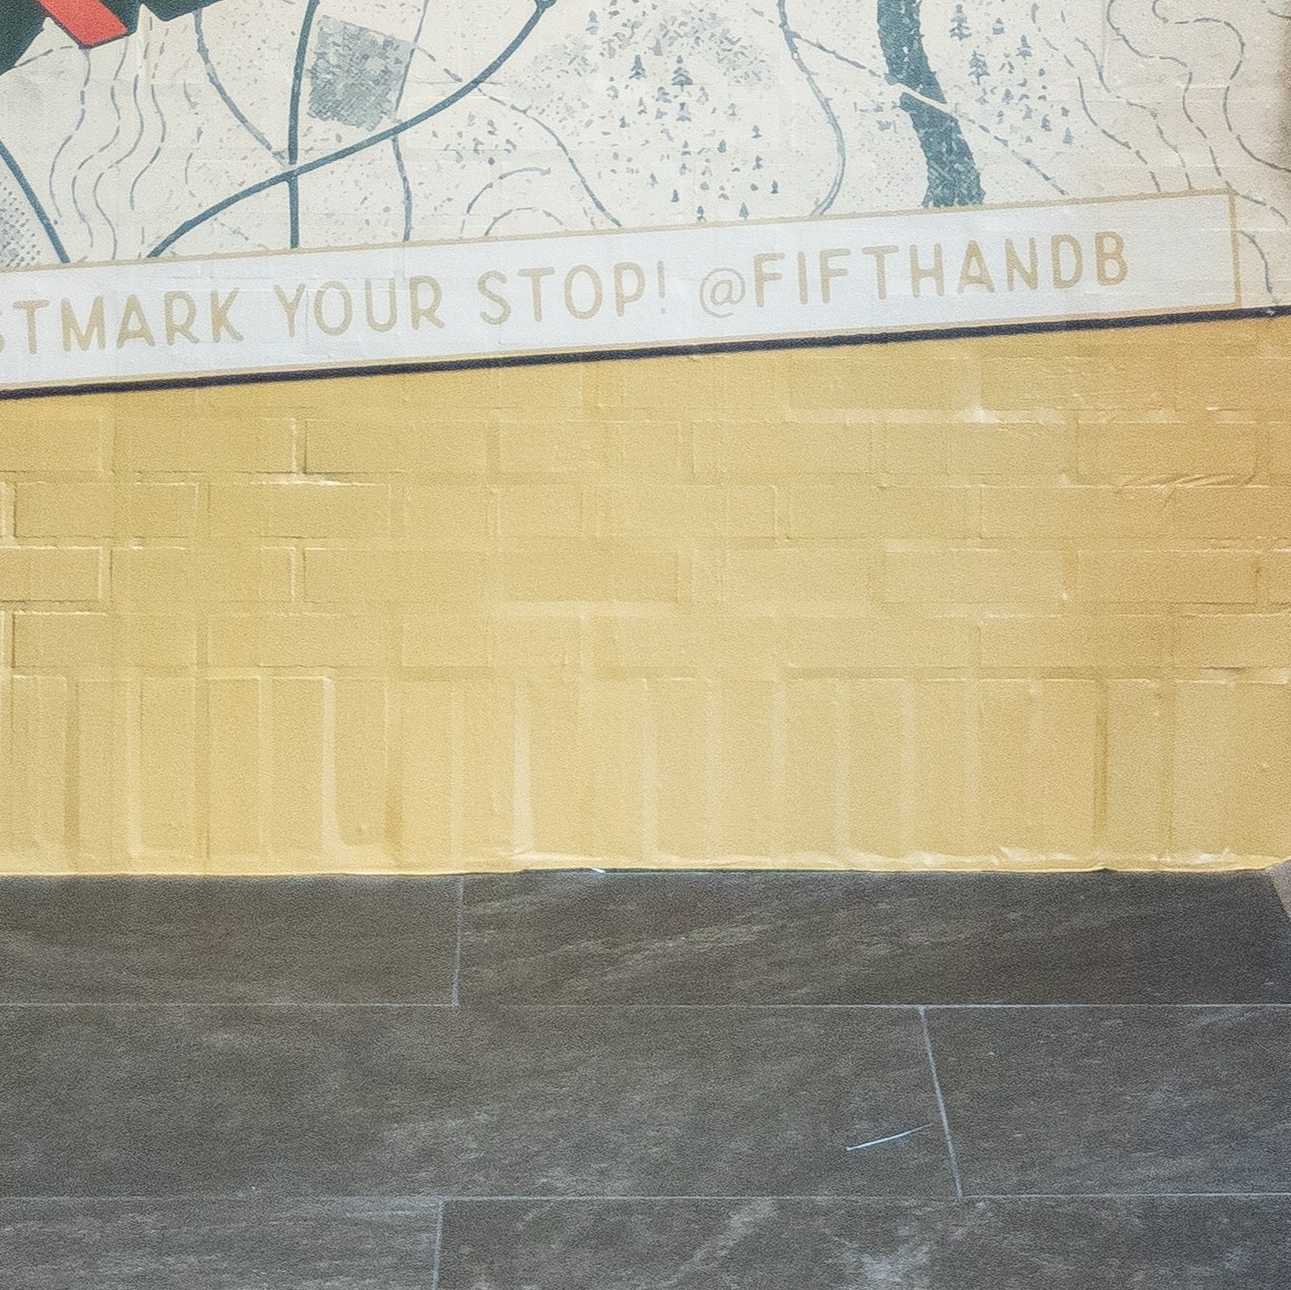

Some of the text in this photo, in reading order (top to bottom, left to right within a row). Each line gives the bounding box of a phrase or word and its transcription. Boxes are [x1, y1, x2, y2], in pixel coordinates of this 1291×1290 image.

[272, 274, 446, 338] YOUR
[476, 259, 669, 327] STOP!
[698, 229, 1130, 319] @FIFTHANDB
